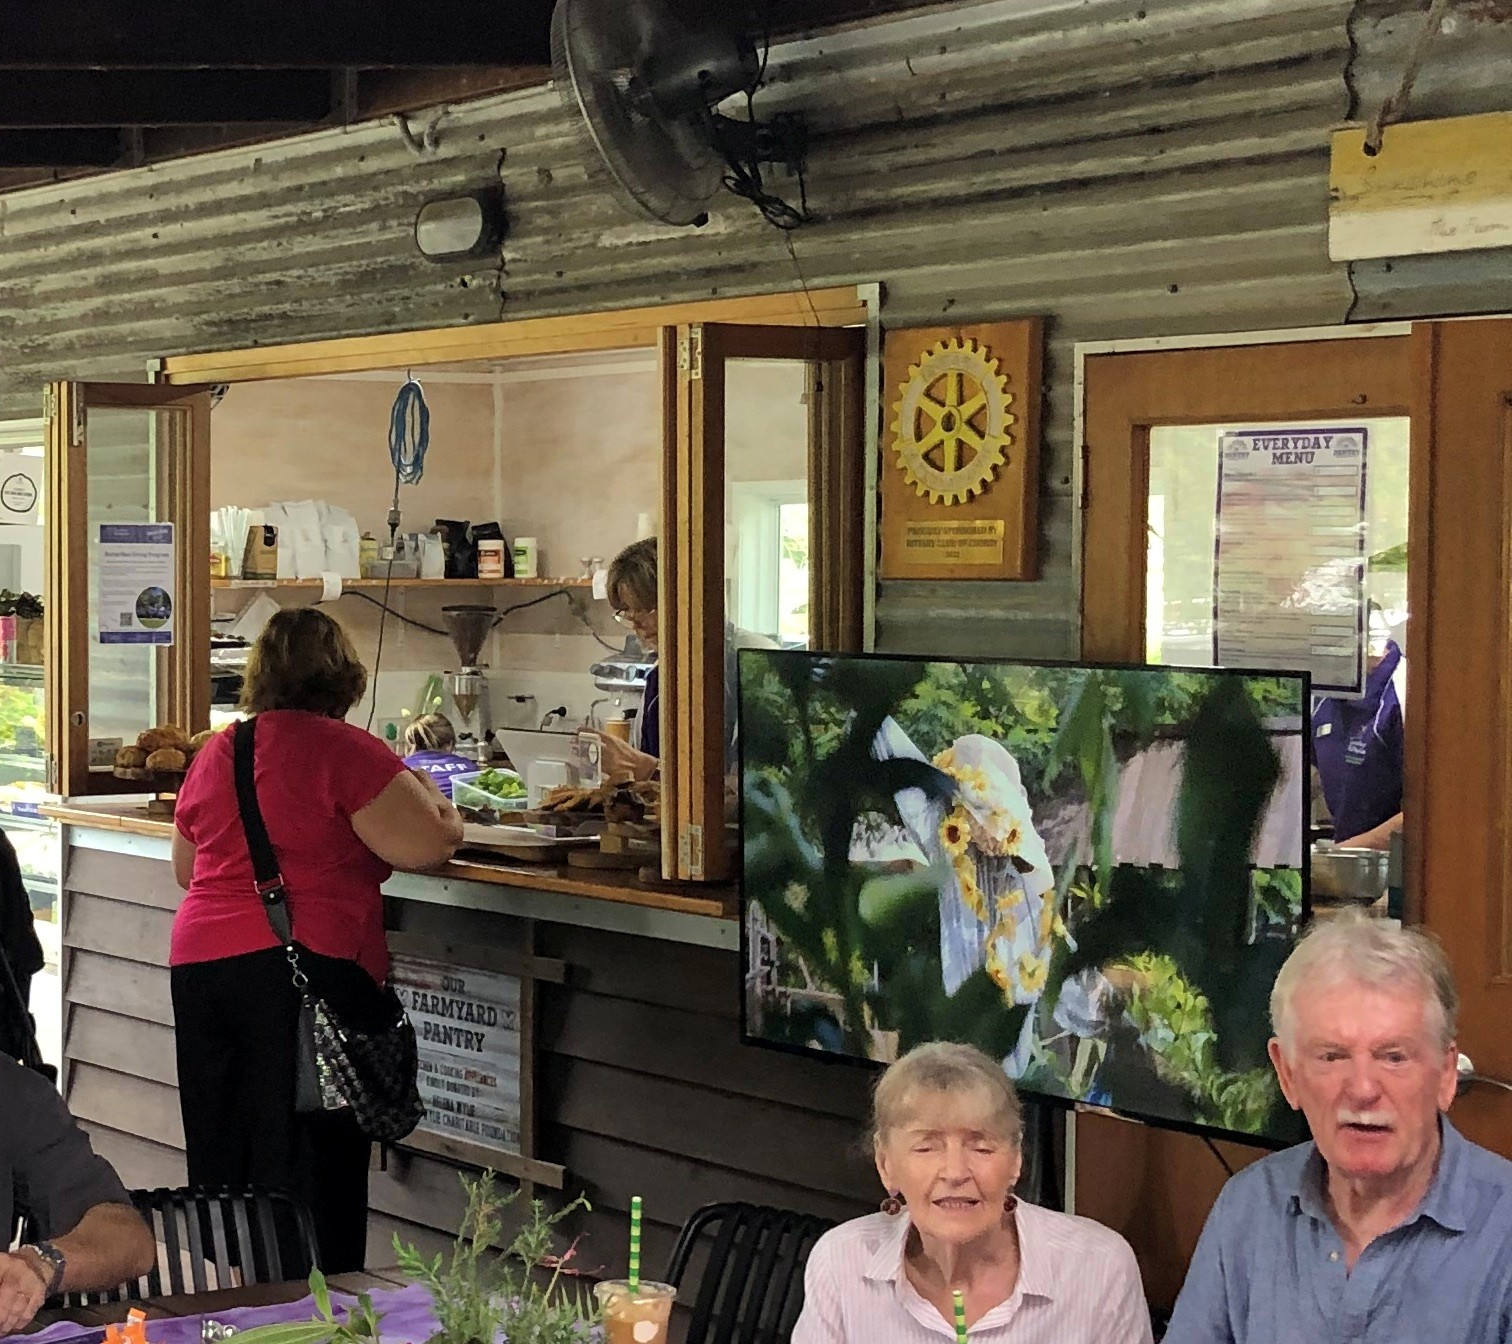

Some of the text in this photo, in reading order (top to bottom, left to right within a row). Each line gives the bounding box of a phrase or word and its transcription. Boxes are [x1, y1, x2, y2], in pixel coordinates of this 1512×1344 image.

[1251, 436, 1334, 452] EVERYDAY
[1271, 451, 1316, 465] MENU
[441, 975, 465, 994] OUR
[411, 991, 498, 1027] FARMYARD
[423, 1021, 486, 1052] PANTRY
